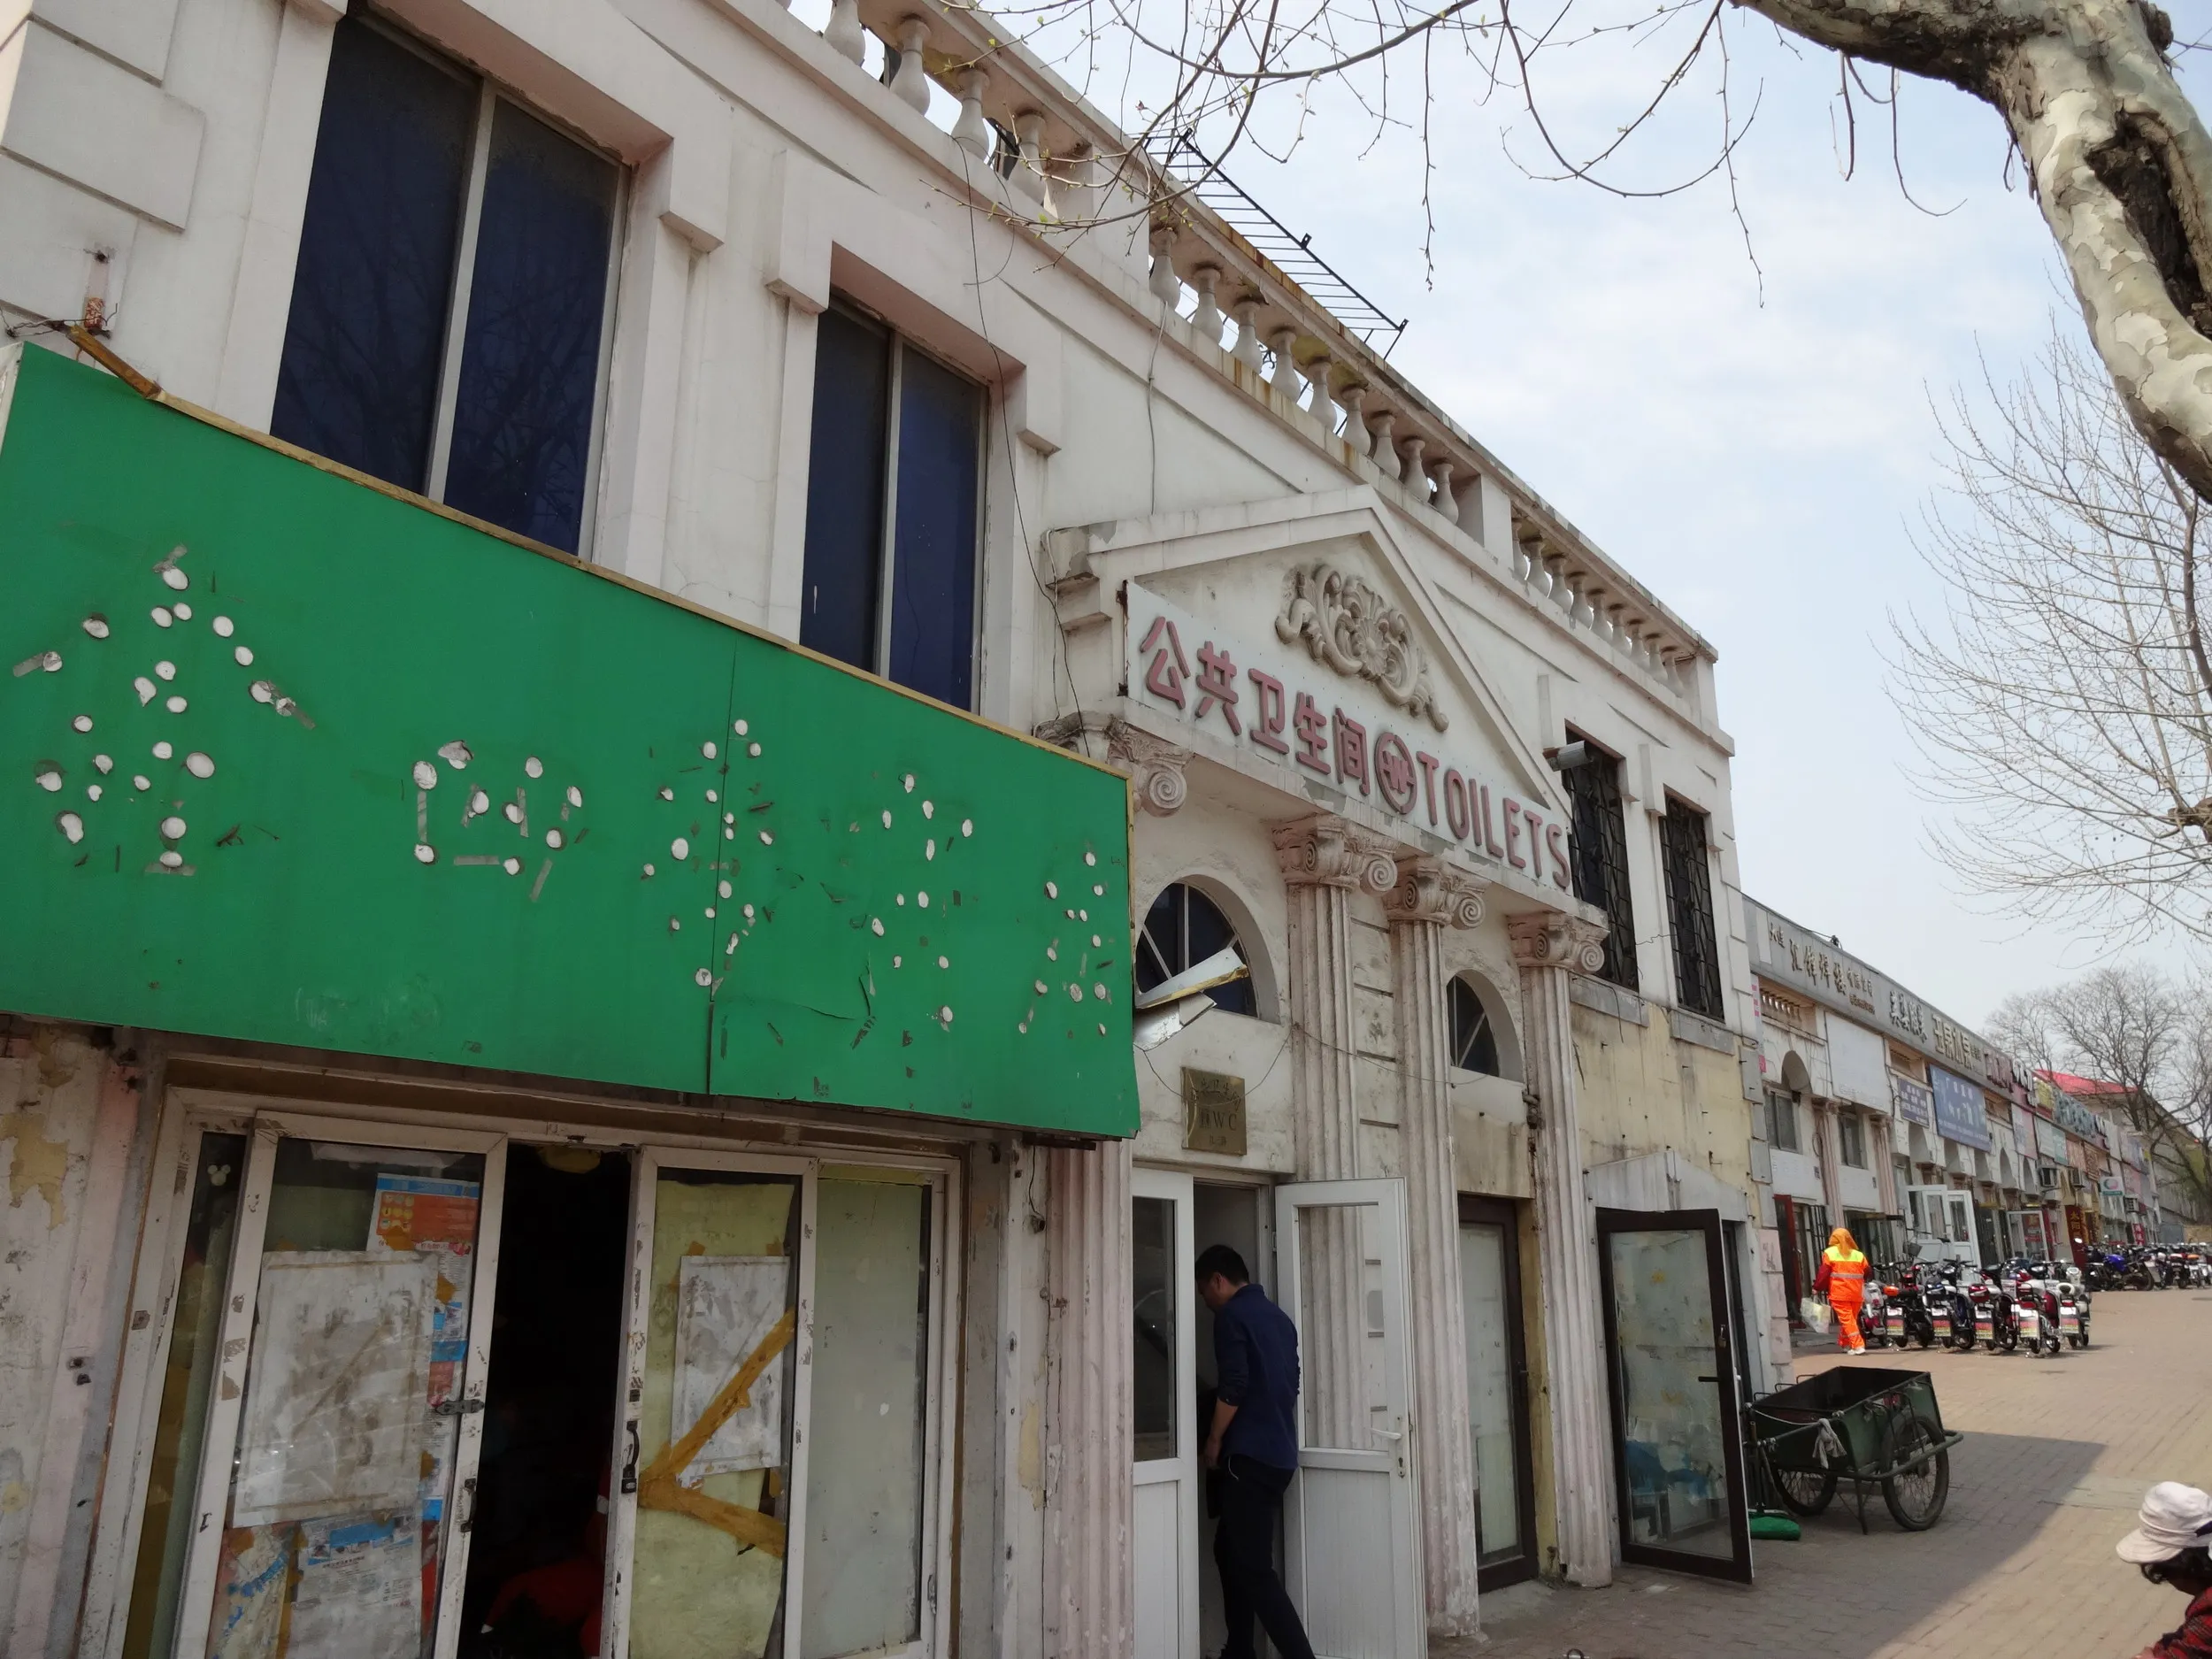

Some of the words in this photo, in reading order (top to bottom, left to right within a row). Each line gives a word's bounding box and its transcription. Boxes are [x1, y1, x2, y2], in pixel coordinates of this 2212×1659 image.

[1140, 616, 1372, 796] 公共卫生间
[1416, 750, 1571, 888] TOILETS
